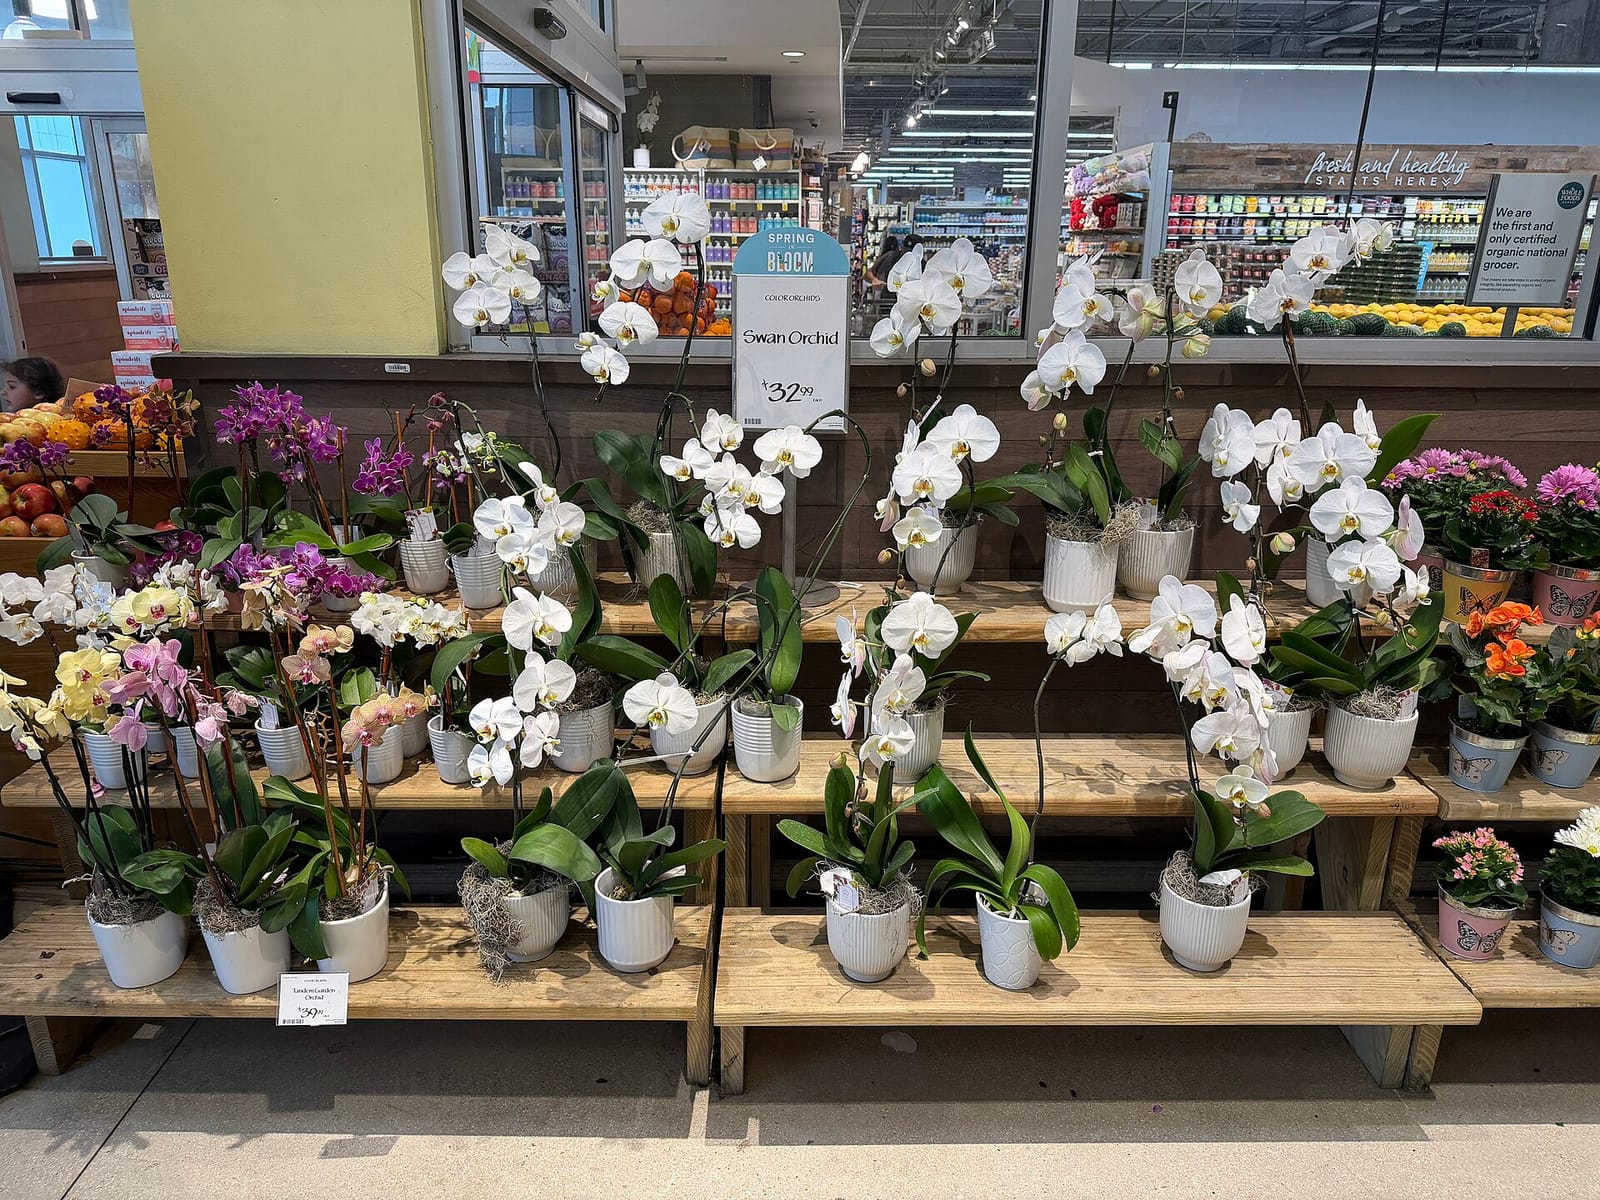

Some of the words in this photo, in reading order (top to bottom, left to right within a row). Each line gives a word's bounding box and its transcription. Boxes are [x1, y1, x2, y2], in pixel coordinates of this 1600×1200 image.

[1167, 94, 1173, 105] 1
[1304, 149, 1354, 184] fresh
[1360, 148, 1400, 180] and
[1400, 150, 1471, 185] healthy
[1394, 176, 1438, 186] HERE
[1496, 207, 1514, 217] We
[1515, 209, 1532, 218] are
[1492, 220, 1509, 230] the
[1511, 220, 1532, 231] first
[1533, 220, 1554, 231] and
[768, 233, 815, 243] SPRING
[1489, 233, 1512, 246] only
[1513, 233, 1558, 244] certified
[1486, 246, 1525, 259] organic
[1527, 247, 1569, 257] national
[767, 251, 814, 273] BLOOM
[1482, 261, 1519, 271] grocer.
[742, 329, 786, 344] Swan
[788, 330, 839, 345] Orchid
